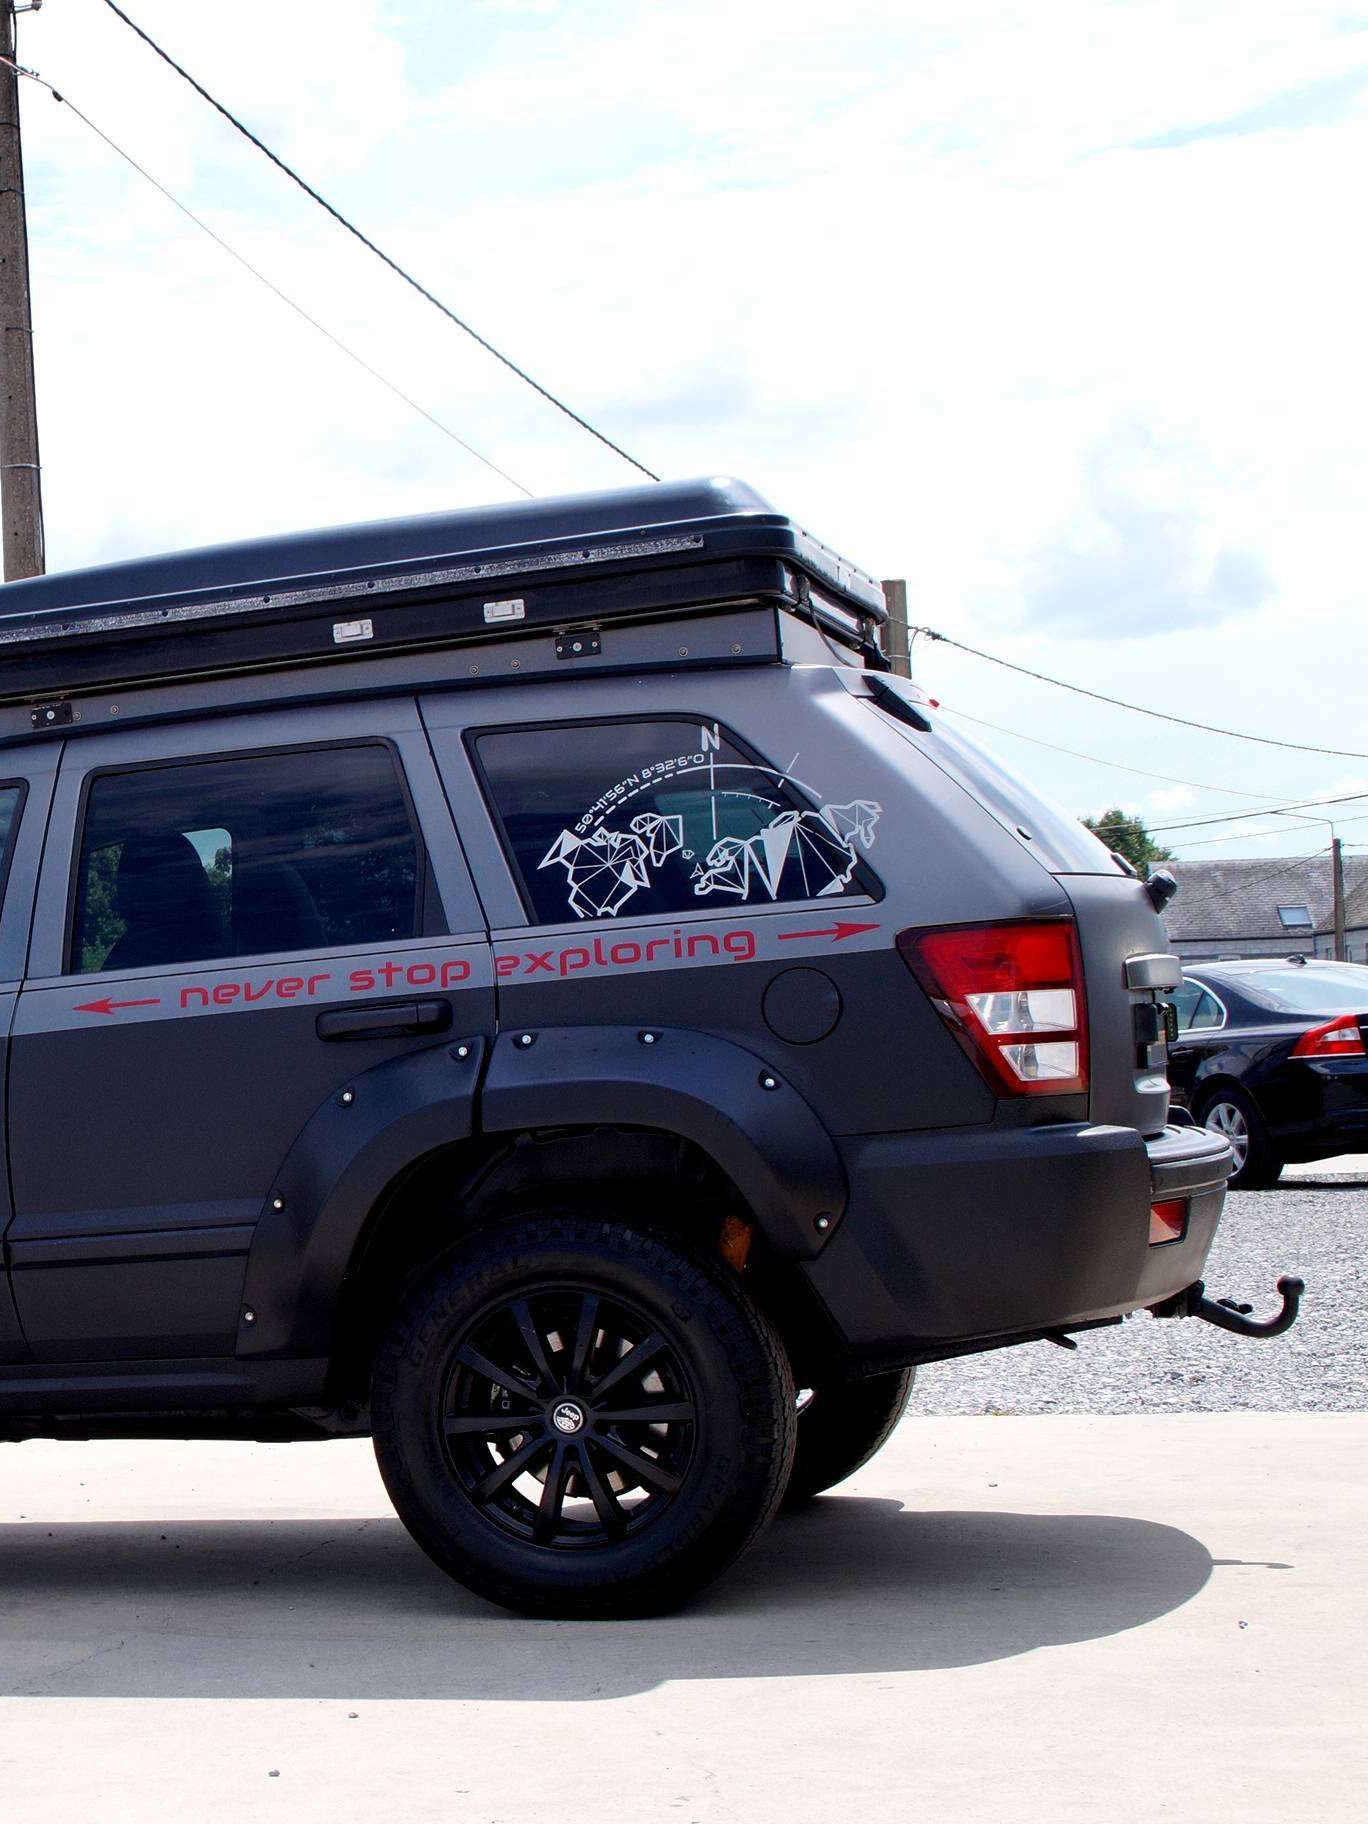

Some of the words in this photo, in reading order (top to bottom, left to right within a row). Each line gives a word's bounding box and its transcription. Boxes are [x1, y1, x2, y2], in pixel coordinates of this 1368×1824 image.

[700, 723, 721, 752] N
[180, 973, 330, 1008] never
[350, 961, 470, 992] stop
[496, 930, 756, 976] exploring
[560, 1406, 580, 1422] Jeep
